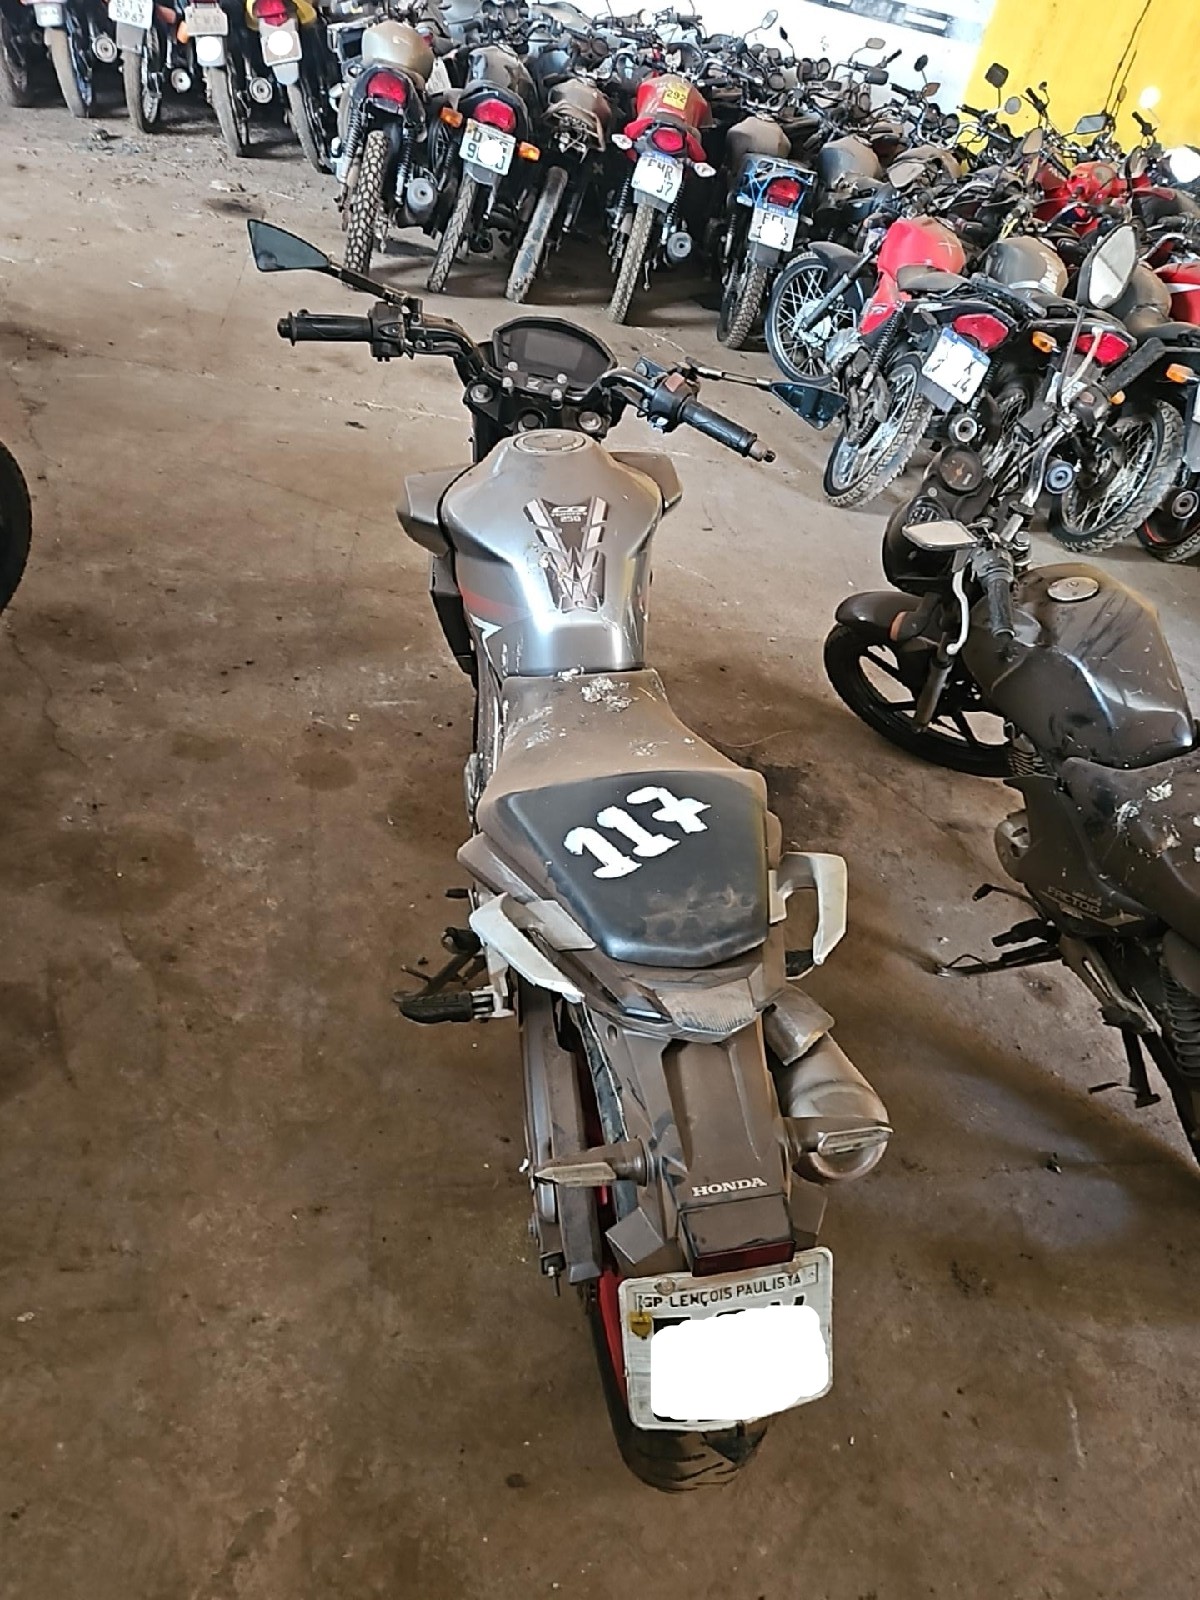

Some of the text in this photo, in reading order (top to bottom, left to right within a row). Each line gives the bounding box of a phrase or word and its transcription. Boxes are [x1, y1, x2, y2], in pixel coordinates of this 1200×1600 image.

[563, 786, 712, 879] 117
[1048, 886, 1101, 916] FACTOR
[692, 1177, 768, 1198] HONDA
[736, 1273, 801, 1298] PAULISTA
